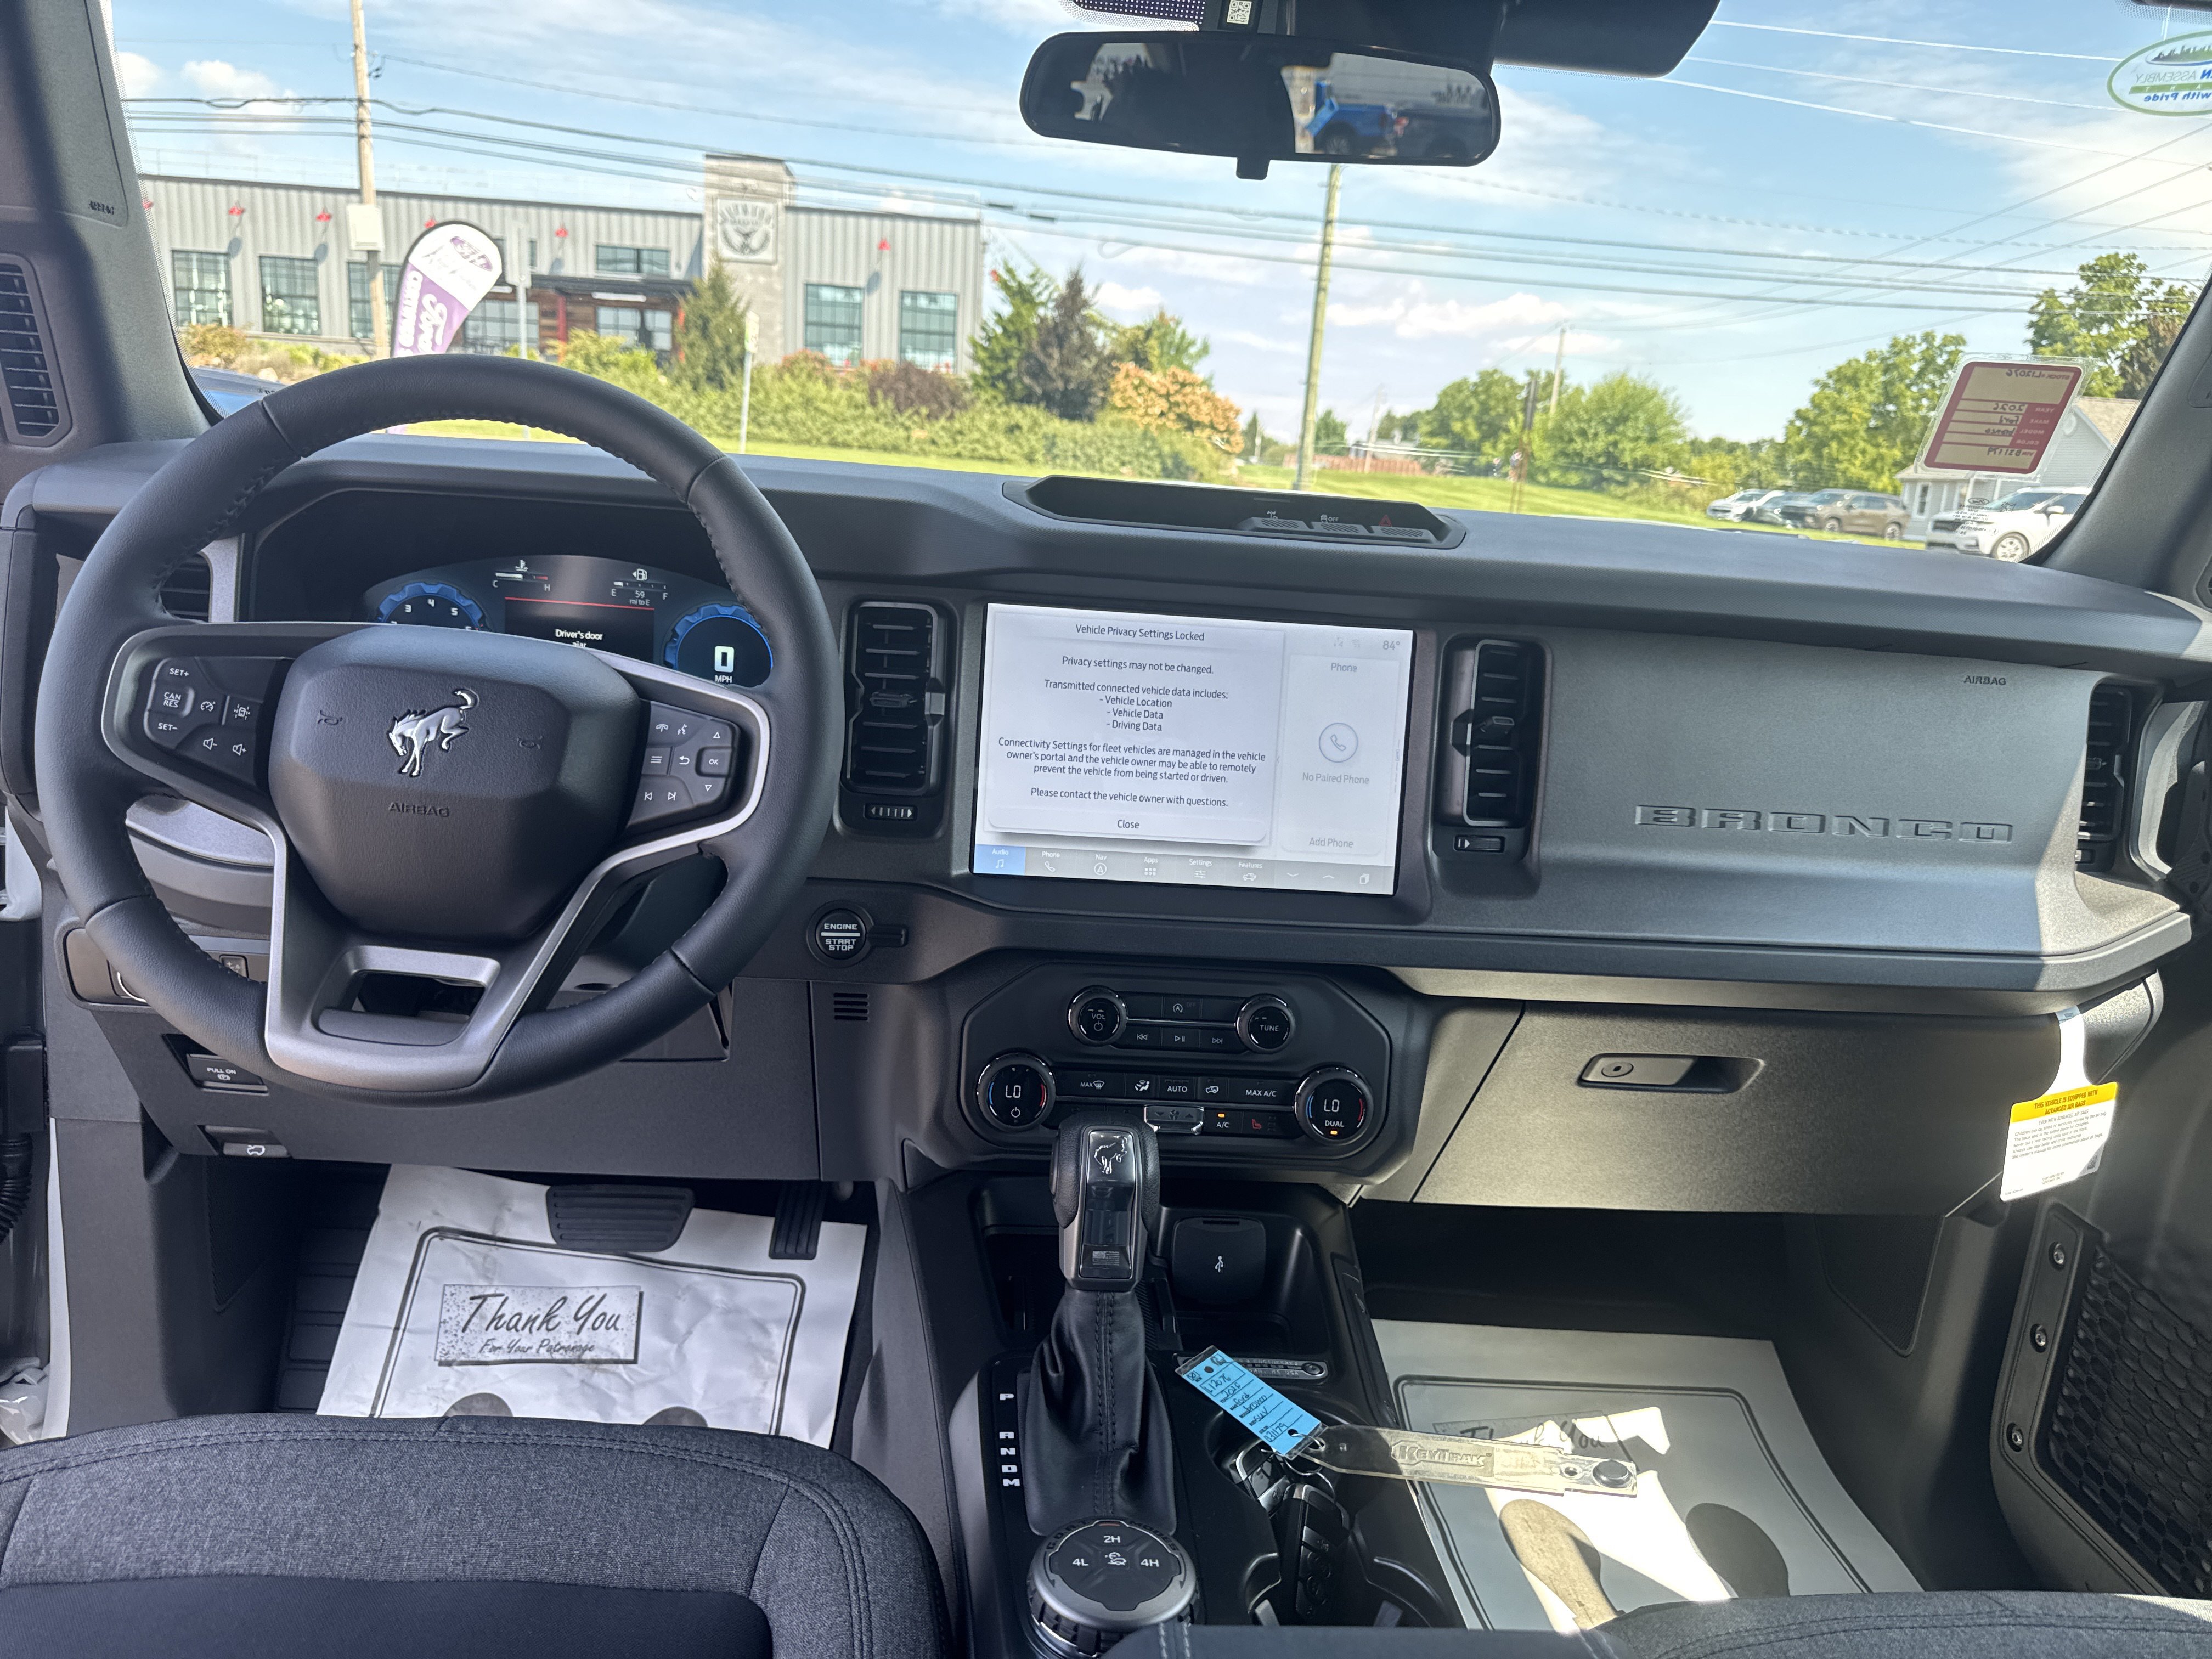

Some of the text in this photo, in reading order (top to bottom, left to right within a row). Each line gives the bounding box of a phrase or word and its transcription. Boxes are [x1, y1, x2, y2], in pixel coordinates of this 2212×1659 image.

[662, 591, 668, 601] F
[555, 629, 603, 640] Driver's door
[1075, 624, 1204, 641] Vehicle Privacy Settings Locked
[715, 646, 734, 673] 0
[1062, 656, 1214, 674] Privacy settings may not be changed.
[170, 668, 189, 676] SET+
[1331, 663, 1357, 673] Phone
[715, 675, 732, 683] MPH
[1963, 674, 2006, 686] AIRBAG
[1044, 679, 1228, 699] Transmitted connected vehicle data includes:
[164, 692, 181, 701] CAN
[1105, 695, 1172, 708] Vehicle Location
[1112, 708, 1164, 719] Vehicle Data
[1111, 720, 1162, 731] Driving Data
[998, 737, 1266, 761] Connectivity Settings for fleet vehicles are managed in the vehicle
[1007, 751, 1256, 775] owner's portal and the vehicle owner may be able to remotely
[1034, 765, 1228, 783] prevent the vehicle from being started or driven.
[1302, 772, 1370, 785] No Paired Phone
[1031, 787, 1228, 807] Please contact the vehicle owner with questions.
[388, 802, 449, 817] AIRBAG
[1117, 819, 1139, 829] Close
[1635, 805, 2013, 844] BRONCO
[1309, 837, 1353, 848] Add Phone
[1042, 851, 1060, 859] Phone
[1189, 859, 1212, 867] Settings
[1005, 1084, 1022, 1099] LO
[1324, 1099, 1340, 1113] LO
[2045, 1098, 2062, 1107] VEHICLE
[2068, 1092, 2087, 1102] EQUIPPED
[2045, 1105, 2067, 1115] ADVANCED
[462, 1293, 568, 1334] Thank
[478, 1338, 501, 1353] For
[507, 1339, 534, 1353] Your
[1000, 1447, 1016, 1455] N
[1001, 1465, 1018, 1473] D
[1002, 1479, 1020, 1487] M
[1130, 1521, 1179, 1551] MODES
